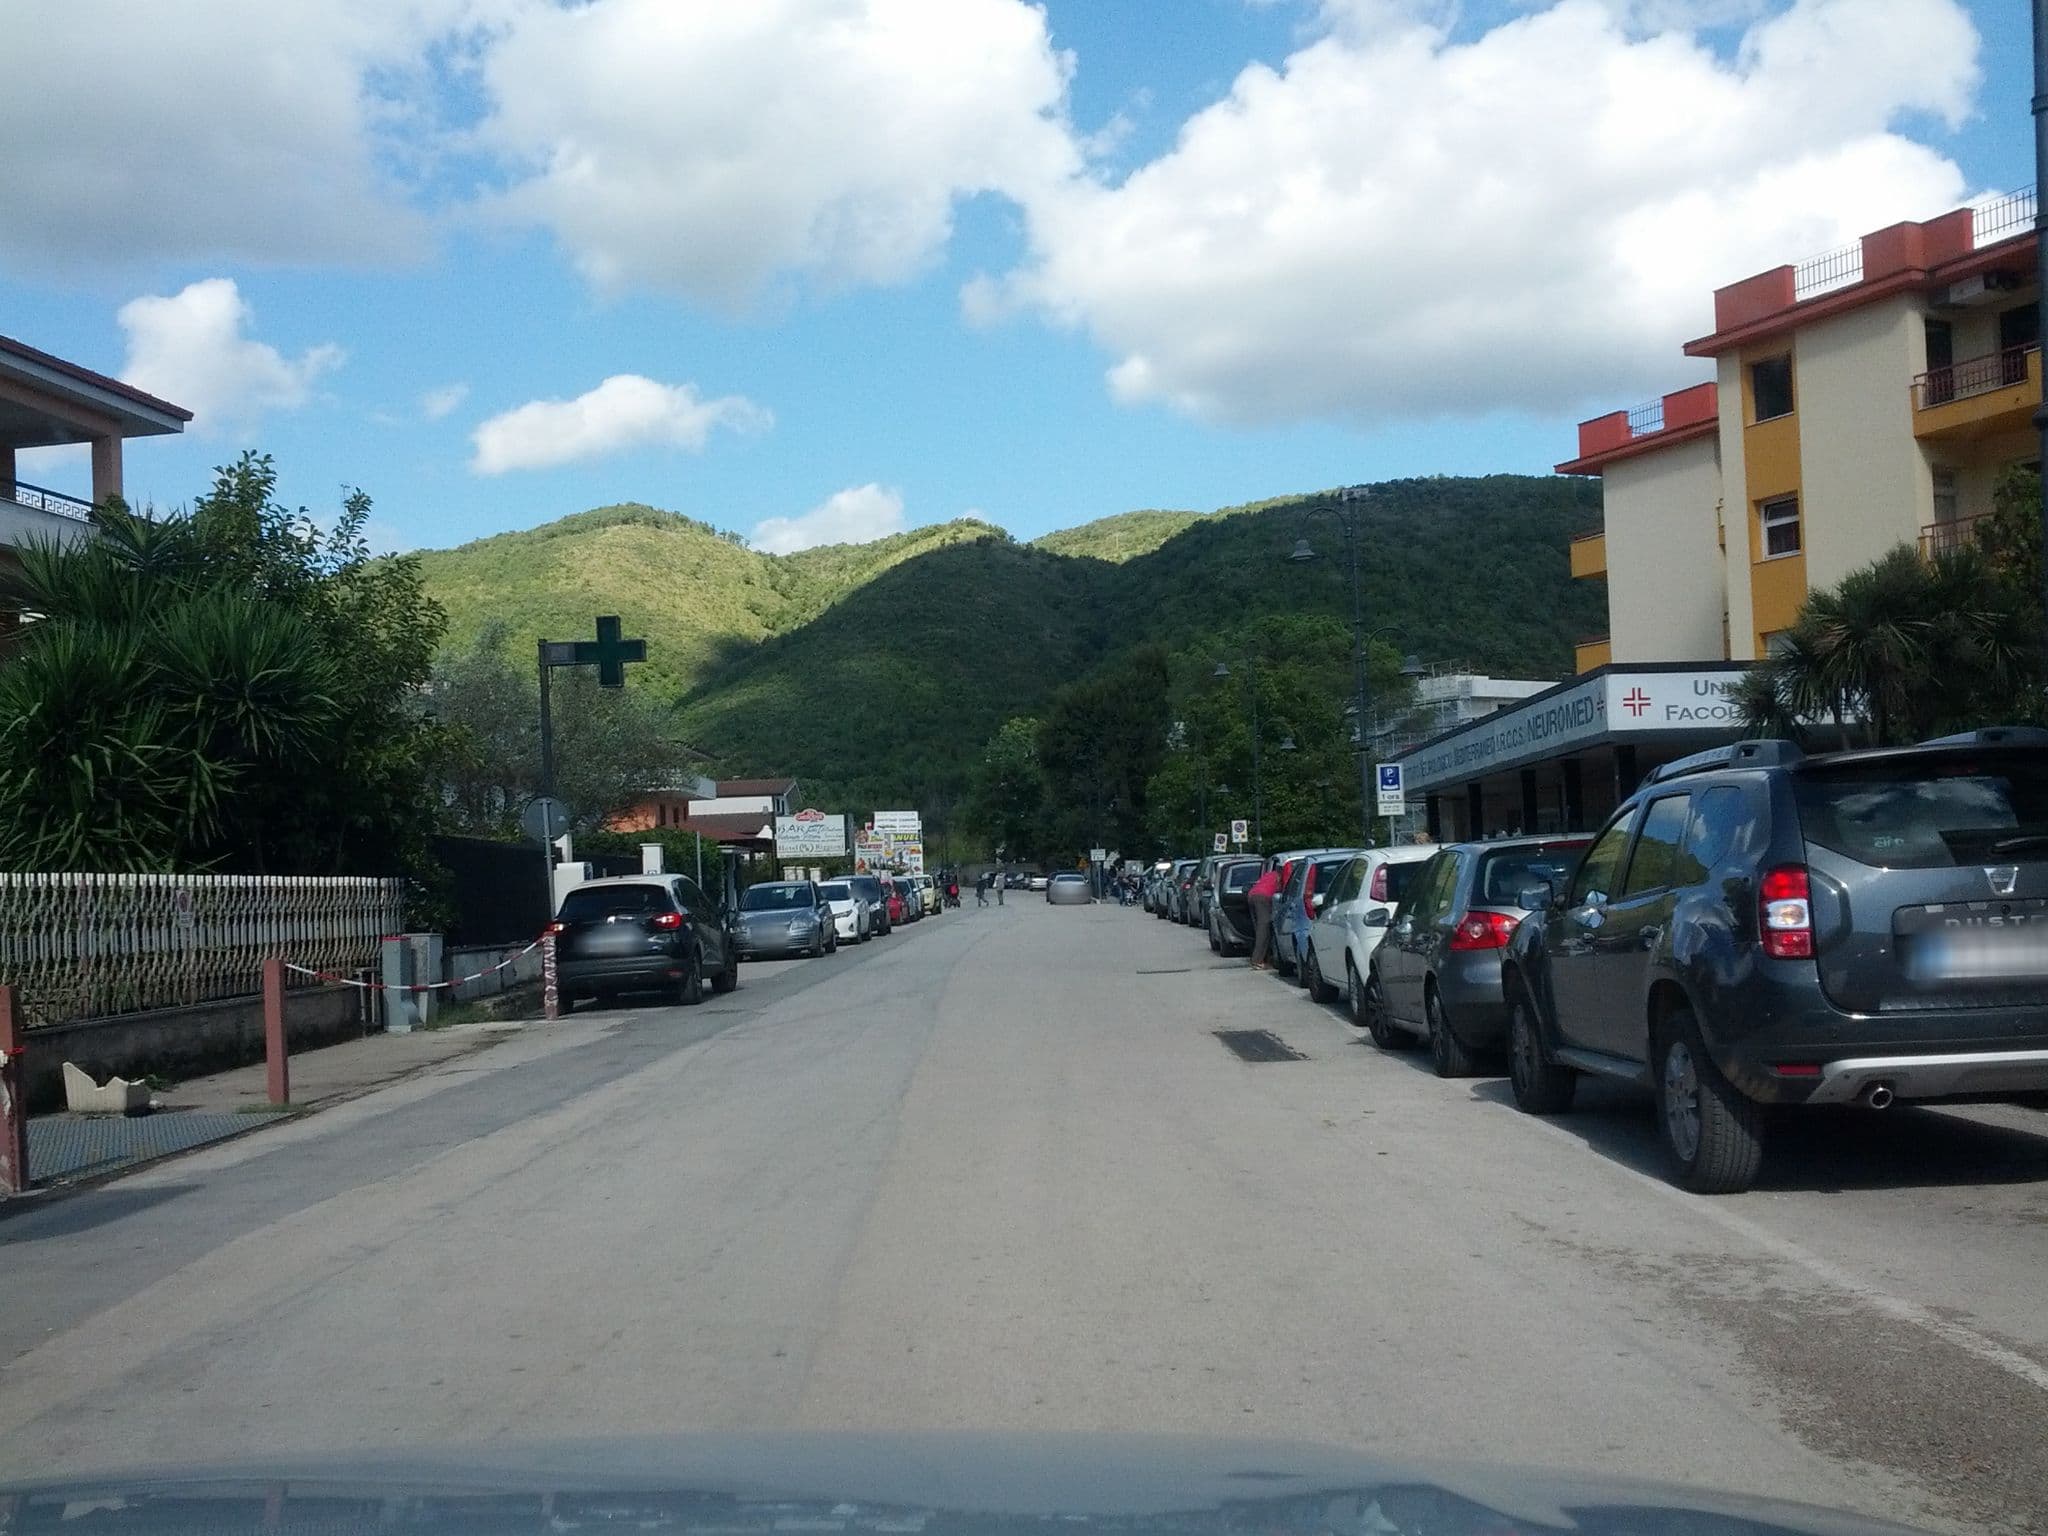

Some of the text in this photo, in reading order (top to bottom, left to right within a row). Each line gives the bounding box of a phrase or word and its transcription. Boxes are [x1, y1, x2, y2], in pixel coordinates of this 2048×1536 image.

[1527, 695, 1594, 742] NEUROMED
[1386, 768, 1394, 777] P
[1945, 914, 2047, 928] DUST
